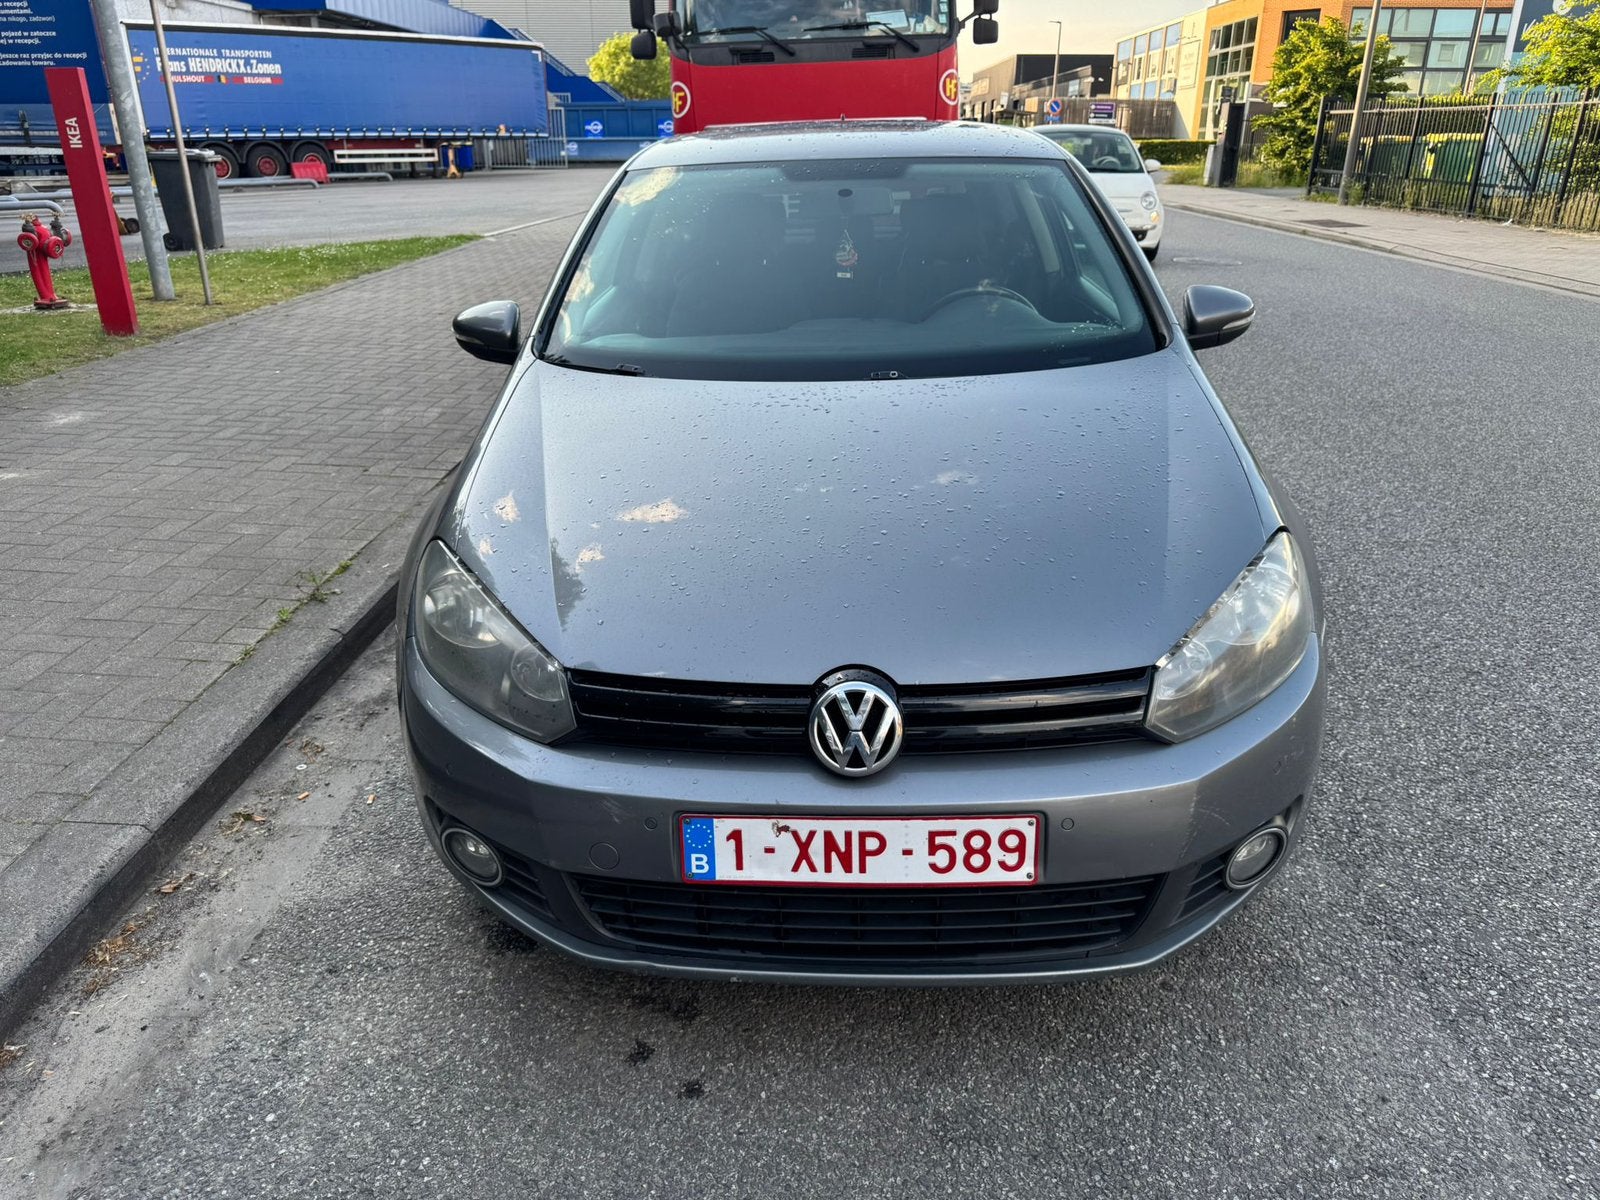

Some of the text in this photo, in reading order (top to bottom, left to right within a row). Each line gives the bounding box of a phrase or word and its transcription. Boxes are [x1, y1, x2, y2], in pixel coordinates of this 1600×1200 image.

[153, 47, 272, 58] IERNATIONALE TRANSPORTEN
[155, 56, 187, 72] Fans
[188, 57, 247, 74] HENDRICKX
[251, 60, 282, 74] Zonen
[243, 76, 272, 84] BELGIUM
[64, 117, 83, 148] IKEA
[690, 853, 710, 874] B
